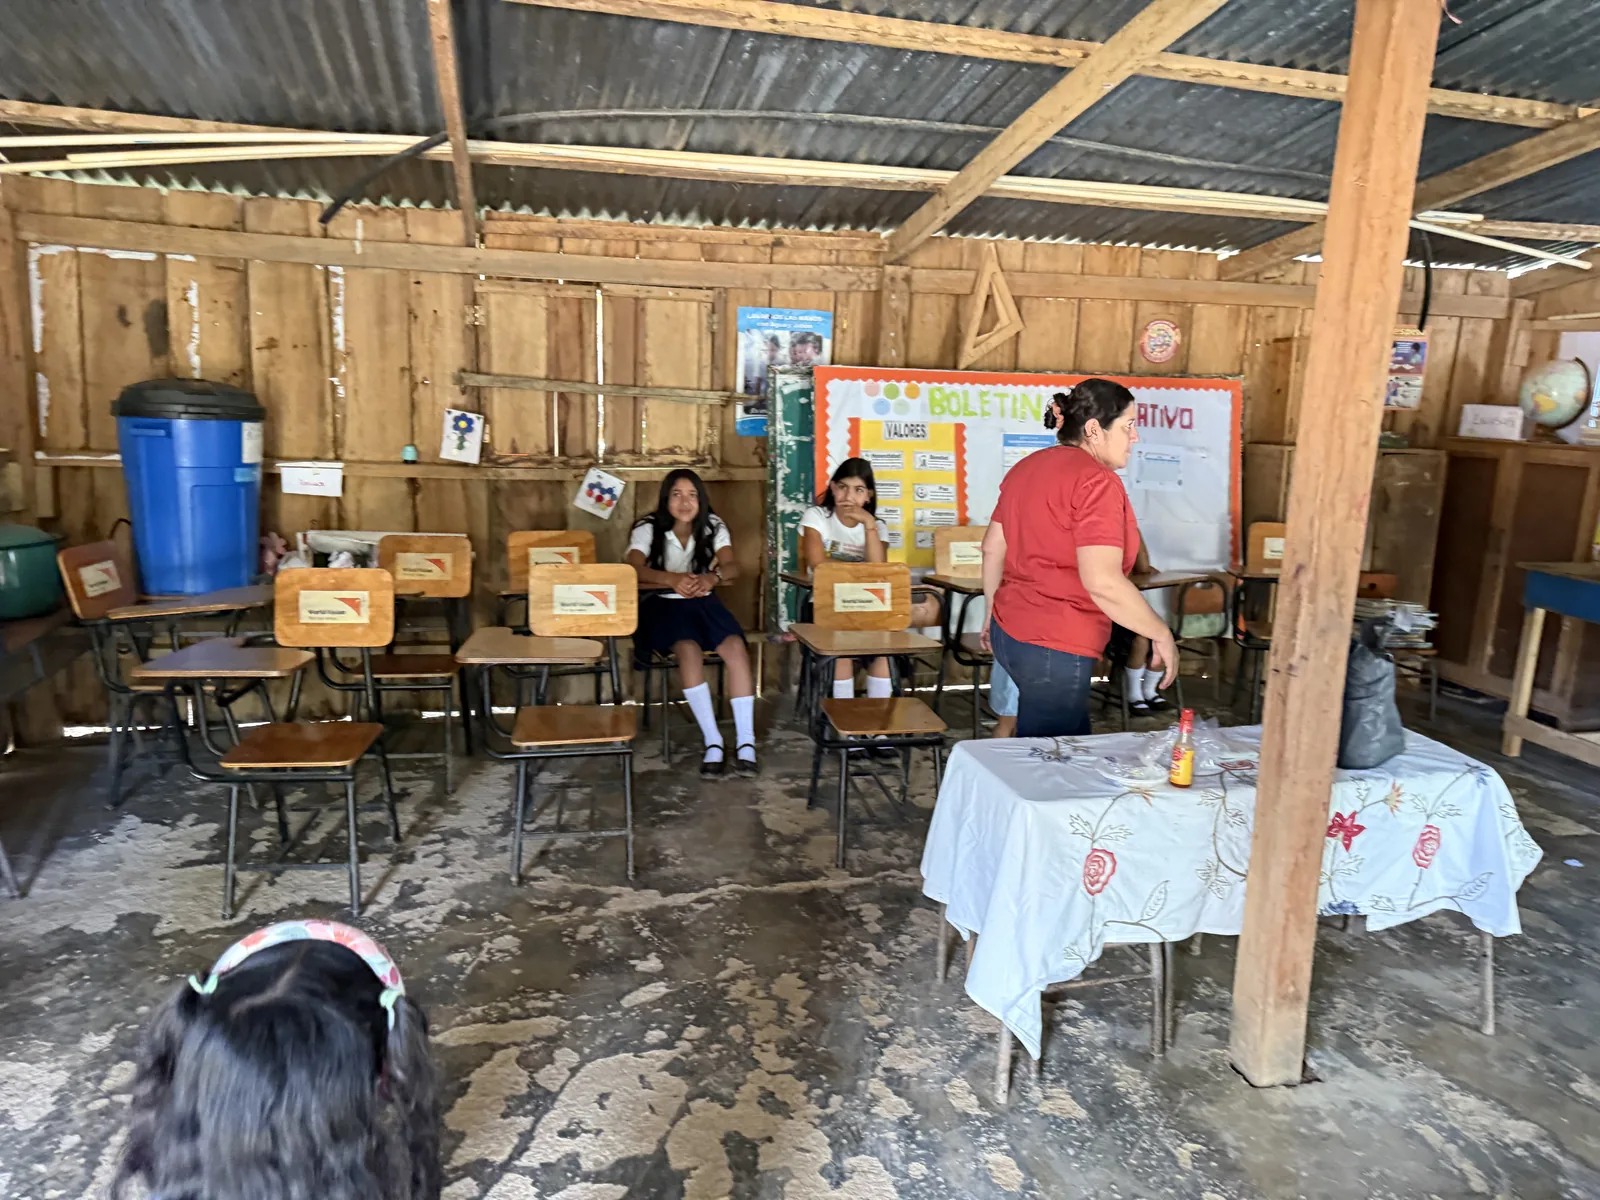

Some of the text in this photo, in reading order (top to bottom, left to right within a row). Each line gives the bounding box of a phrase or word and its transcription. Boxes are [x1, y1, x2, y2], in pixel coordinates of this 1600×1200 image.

[928, 386, 1193, 430] BOLETIN ATIVO
[886, 423, 927, 438] VALORES
